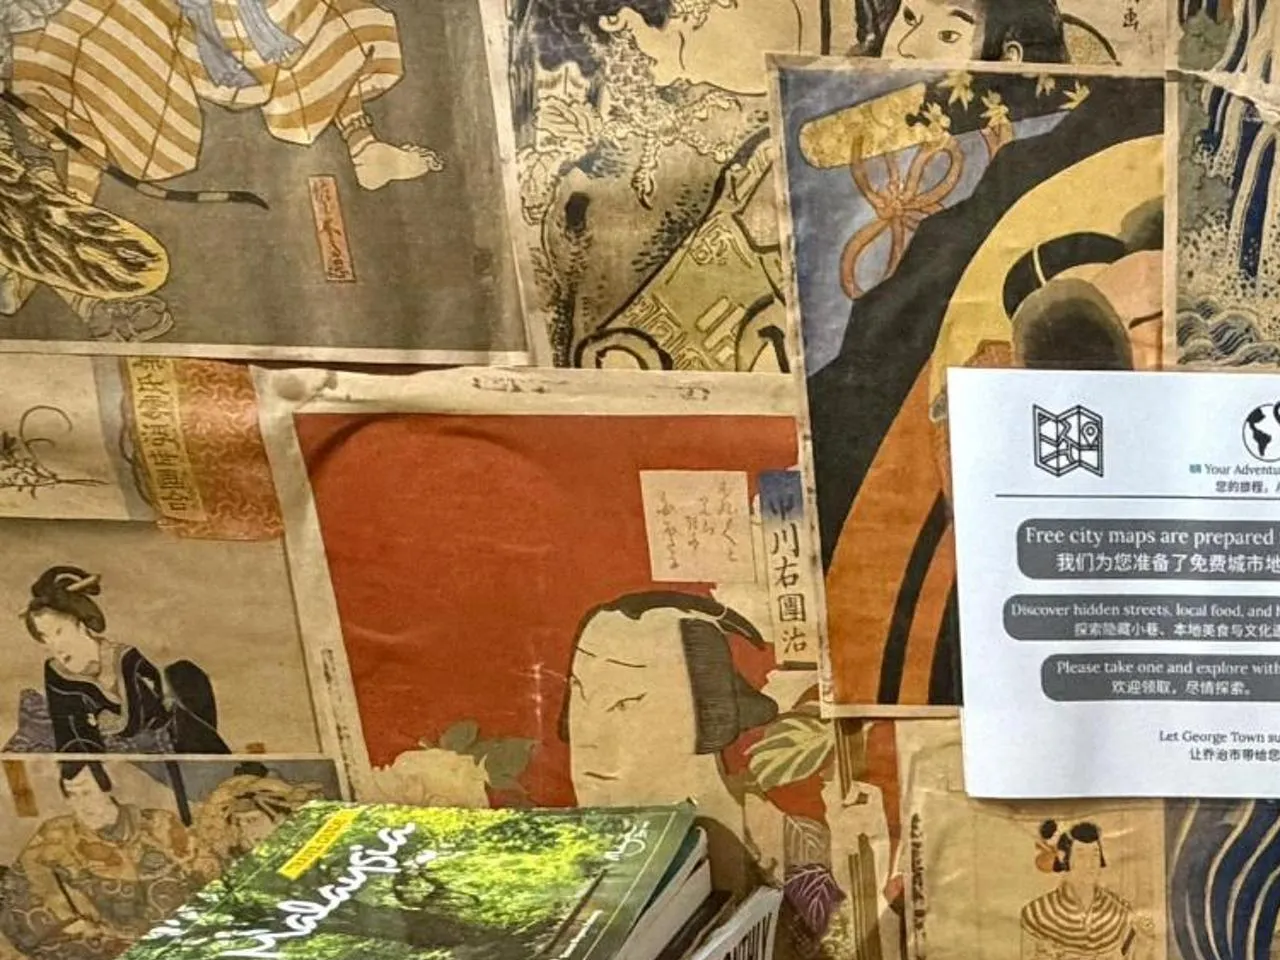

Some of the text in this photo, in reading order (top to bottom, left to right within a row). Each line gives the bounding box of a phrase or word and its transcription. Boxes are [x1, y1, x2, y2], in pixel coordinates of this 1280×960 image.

[1204, 463, 1231, 476] Your
[1025, 526, 1064, 544] Free
[1069, 526, 1101, 548] city
[1108, 531, 1155, 549] maps
[1159, 531, 1188, 544] are
[1194, 527, 1274, 549] prepared
[1010, 603, 1070, 617] Discover
[1073, 602, 1121, 617] hidden
[1176, 602, 1207, 617] local
[1247, 604, 1272, 618] and
[1056, 659, 1101, 674] Please
[1104, 660, 1135, 673] take
[1139, 663, 1163, 674] one
[1167, 660, 1192, 674] and
[1195, 661, 1249, 678] explore
[1159, 730, 1178, 742] Let
[1182, 730, 1228, 745] George
[1230, 731, 1265, 743] Town
